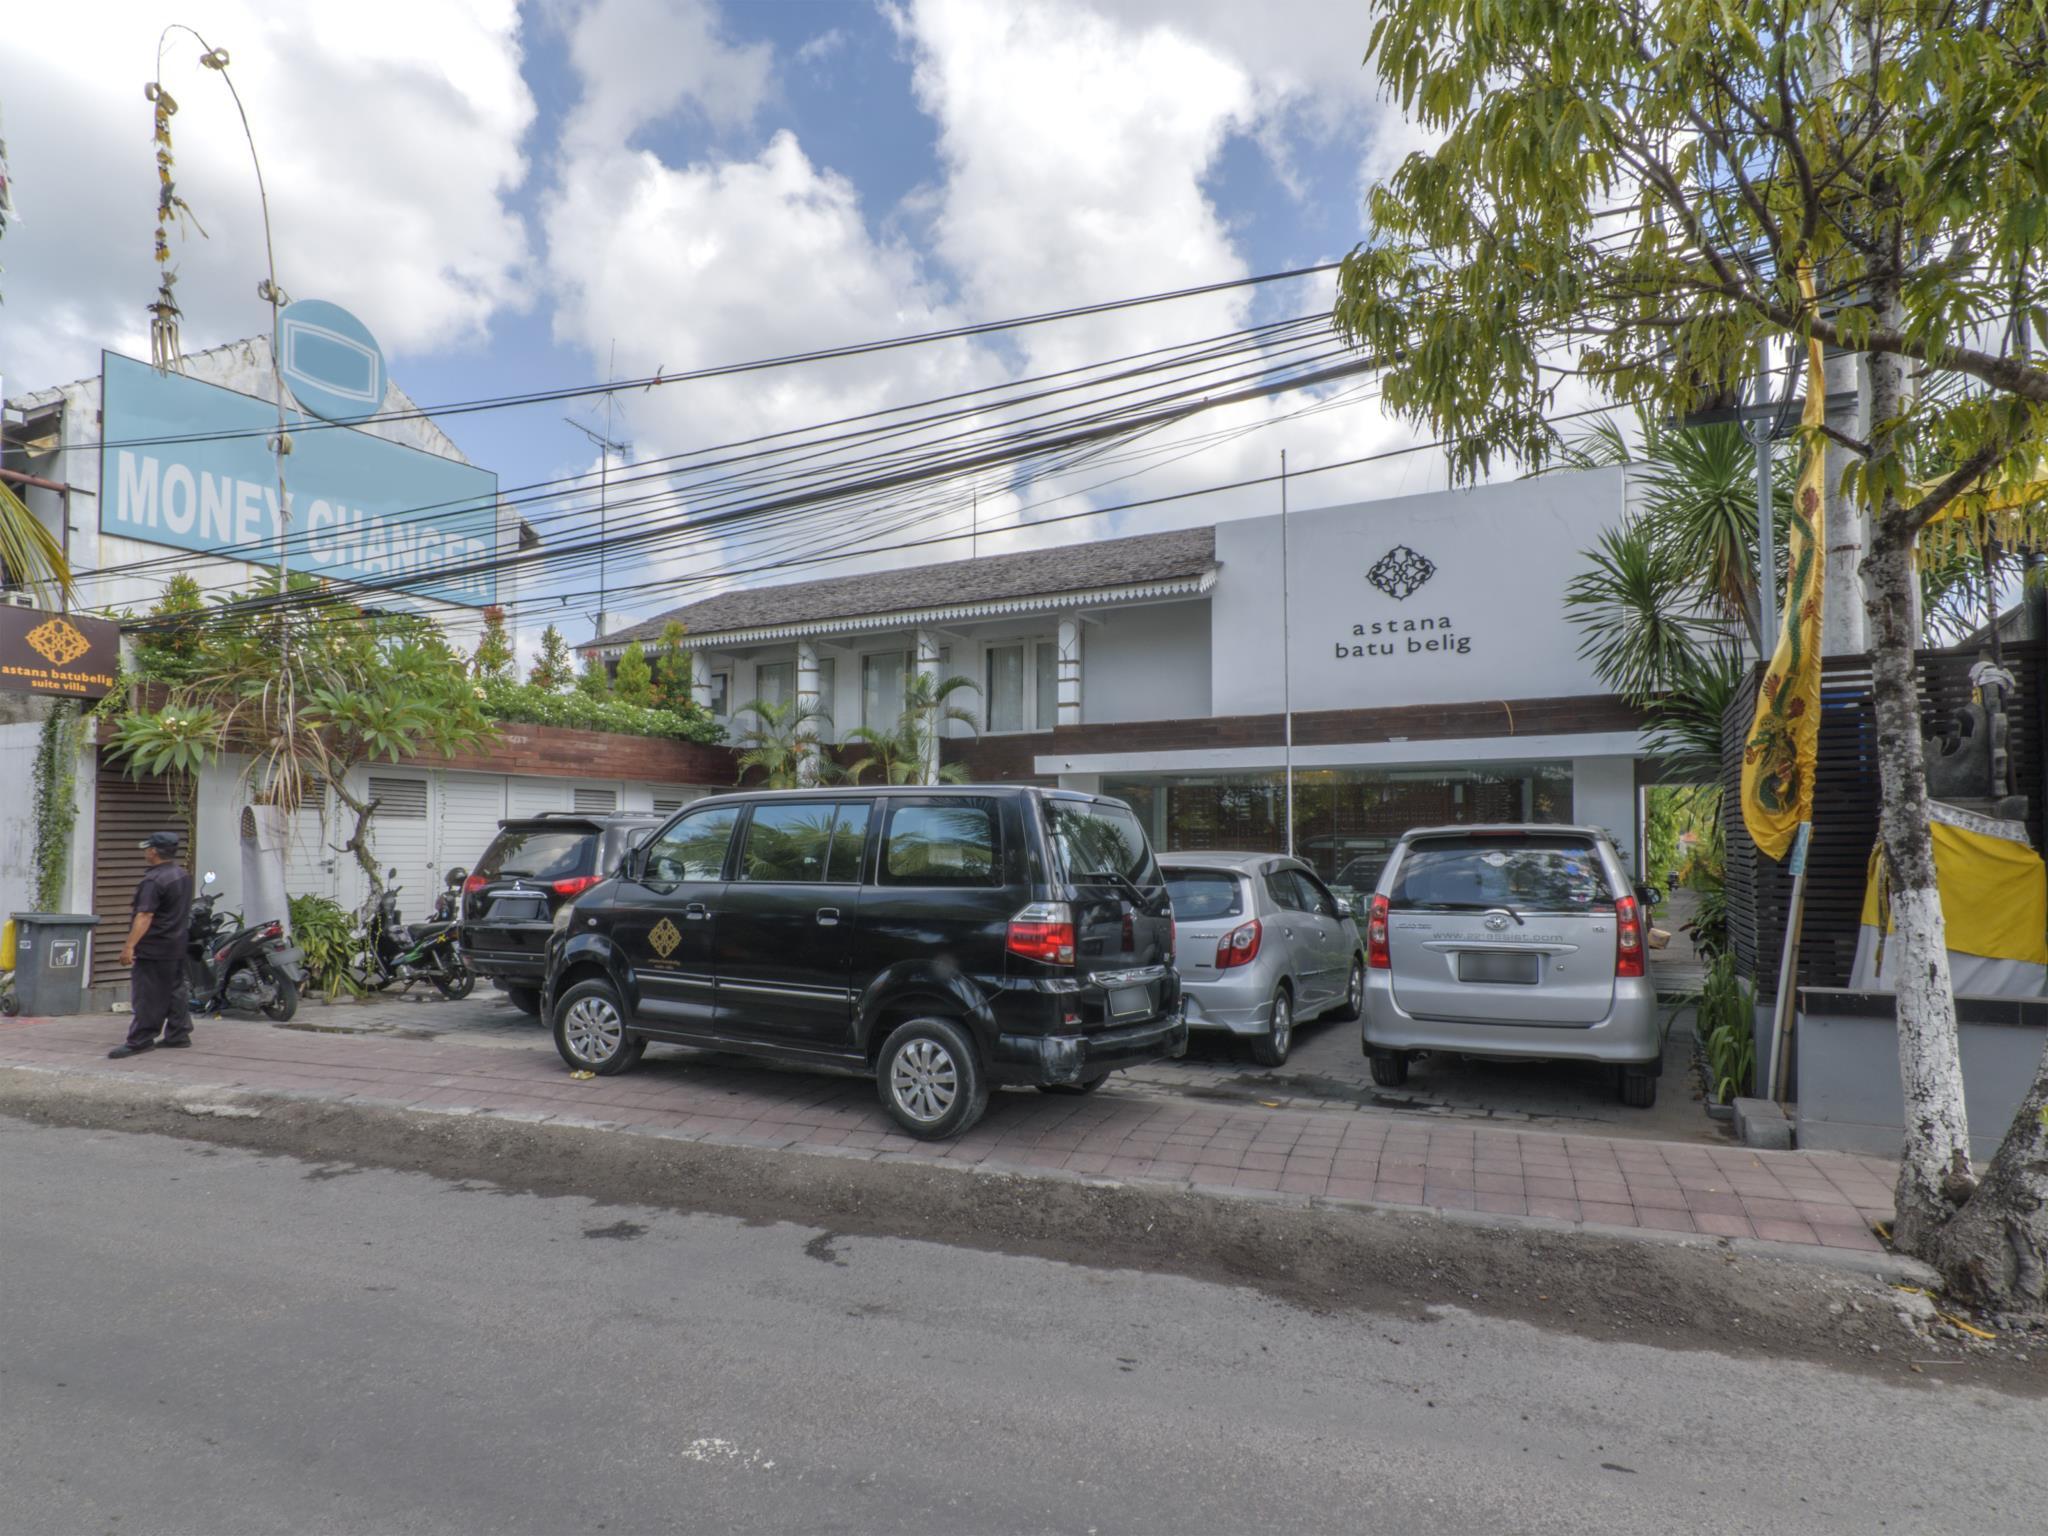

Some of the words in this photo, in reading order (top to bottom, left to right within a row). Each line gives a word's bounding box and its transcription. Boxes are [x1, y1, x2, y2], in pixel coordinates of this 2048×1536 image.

[117, 449, 295, 556] MONEY
[307, 499, 488, 596] CHANGER
[1352, 616, 1452, 636] astana
[1335, 642, 1394, 659] batu
[1407, 633, 1472, 654] belig
[1, 665, 48, 678] astana
[51, 669, 114, 687] batubelig
[31, 679, 60, 689] suite
[63, 682, 87, 692] villa
